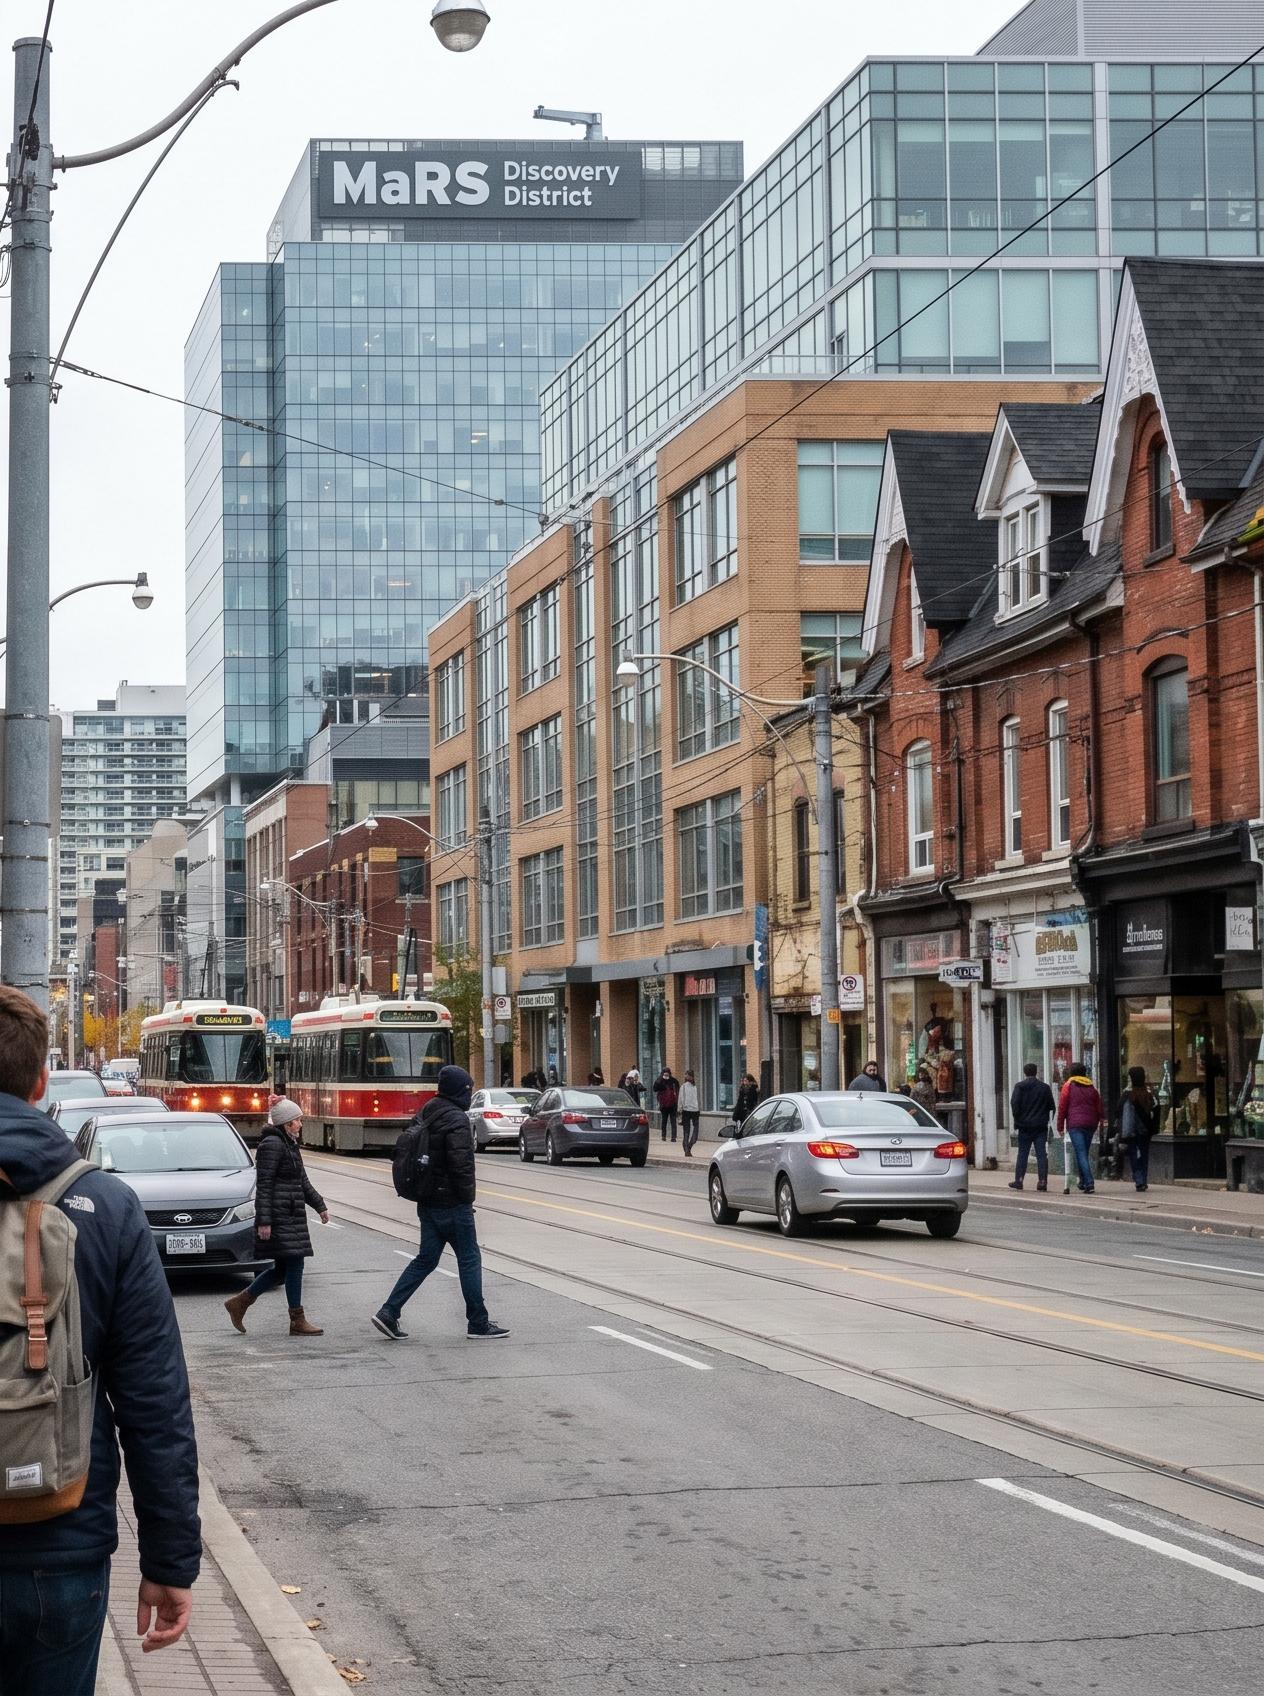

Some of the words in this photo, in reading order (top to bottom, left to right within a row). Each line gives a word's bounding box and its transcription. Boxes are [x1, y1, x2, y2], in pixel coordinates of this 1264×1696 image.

[333, 160, 490, 205] MaRS
[504, 160, 620, 185] Discovery
[504, 185, 592, 206] District
